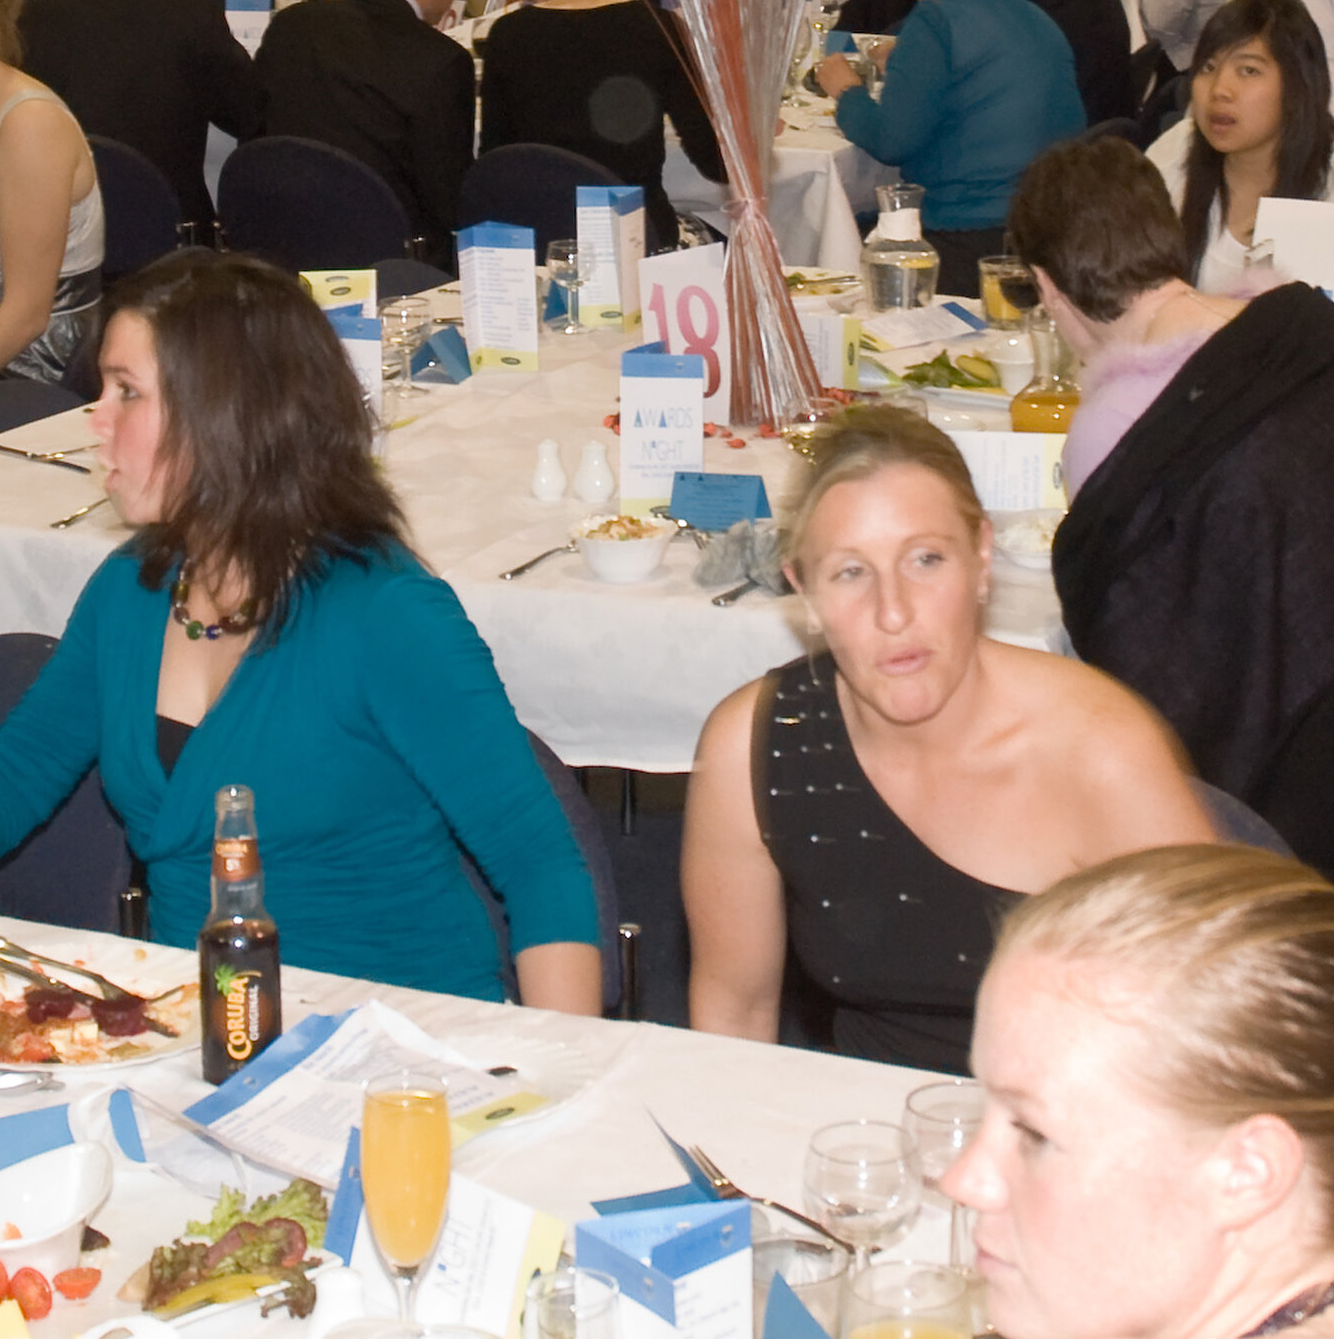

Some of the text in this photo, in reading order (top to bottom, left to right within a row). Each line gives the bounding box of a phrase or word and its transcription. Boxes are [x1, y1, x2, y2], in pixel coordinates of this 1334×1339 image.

[647, 281, 721, 399] 18
[633, 407, 693, 429] AWARDS
[226, 976, 253, 1061] CORUBA
[248, 983, 260, 1042] ORIGINAL
